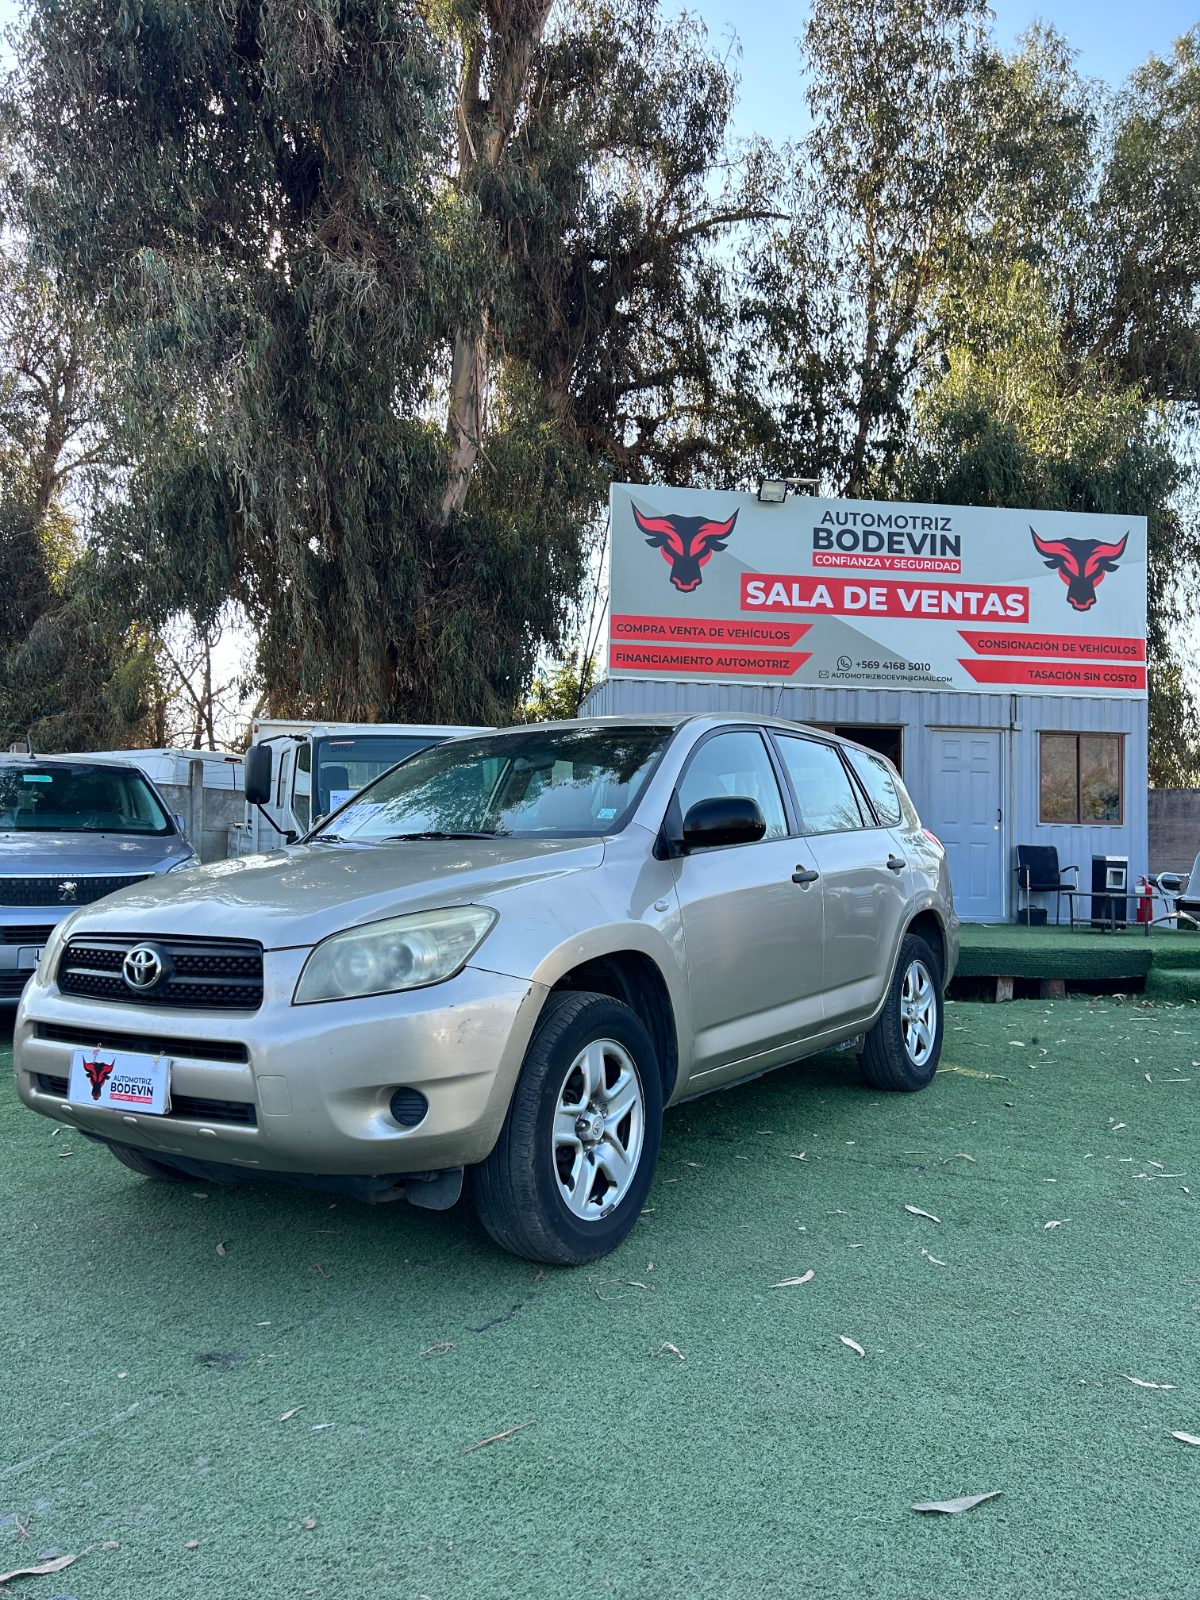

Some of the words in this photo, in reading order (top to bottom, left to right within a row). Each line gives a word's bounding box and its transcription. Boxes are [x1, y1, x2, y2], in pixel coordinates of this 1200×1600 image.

[821, 511, 952, 531] AUTOMOTRIZ
[813, 527, 961, 557] BODEVIN
[815, 555, 881, 567] CONFIANZA
[884, 558, 892, 568] Y
[894, 559, 960, 571] SEGURIDAD
[746, 581, 834, 609] SALA
[844, 586, 888, 611] DE
[897, 588, 1025, 617] VENTAS
[616, 623, 666, 635] COMPRA
[669, 626, 706, 637] VENTA
[709, 627, 724, 637] DE
[727, 627, 790, 640] VEHÍCULOS
[977, 639, 1059, 652] CONSIGNACIÓN
[1062, 643, 1076, 652] DE
[1078, 642, 1137, 655] VEHÍCULOS
[616, 653, 713, 666] FINANCIAMIENTO
[716, 657, 790, 669] AUTOMOTRIZ
[856, 660, 880, 669] +569
[883, 661, 905, 670] 4168
[908, 662, 931, 671] 5010
[831, 672, 953, 683] AUTOMOTRIZBODEVIN@GMAIL.COM
[1028, 669, 1081, 681] TASACIÓN
[1084, 672, 1100, 681] SIN
[1103, 673, 1137, 683] COSTO
[113, 1074, 152, 1085] AUTOMOTRIZ
[110, 1082, 154, 1096] BODEVIN
